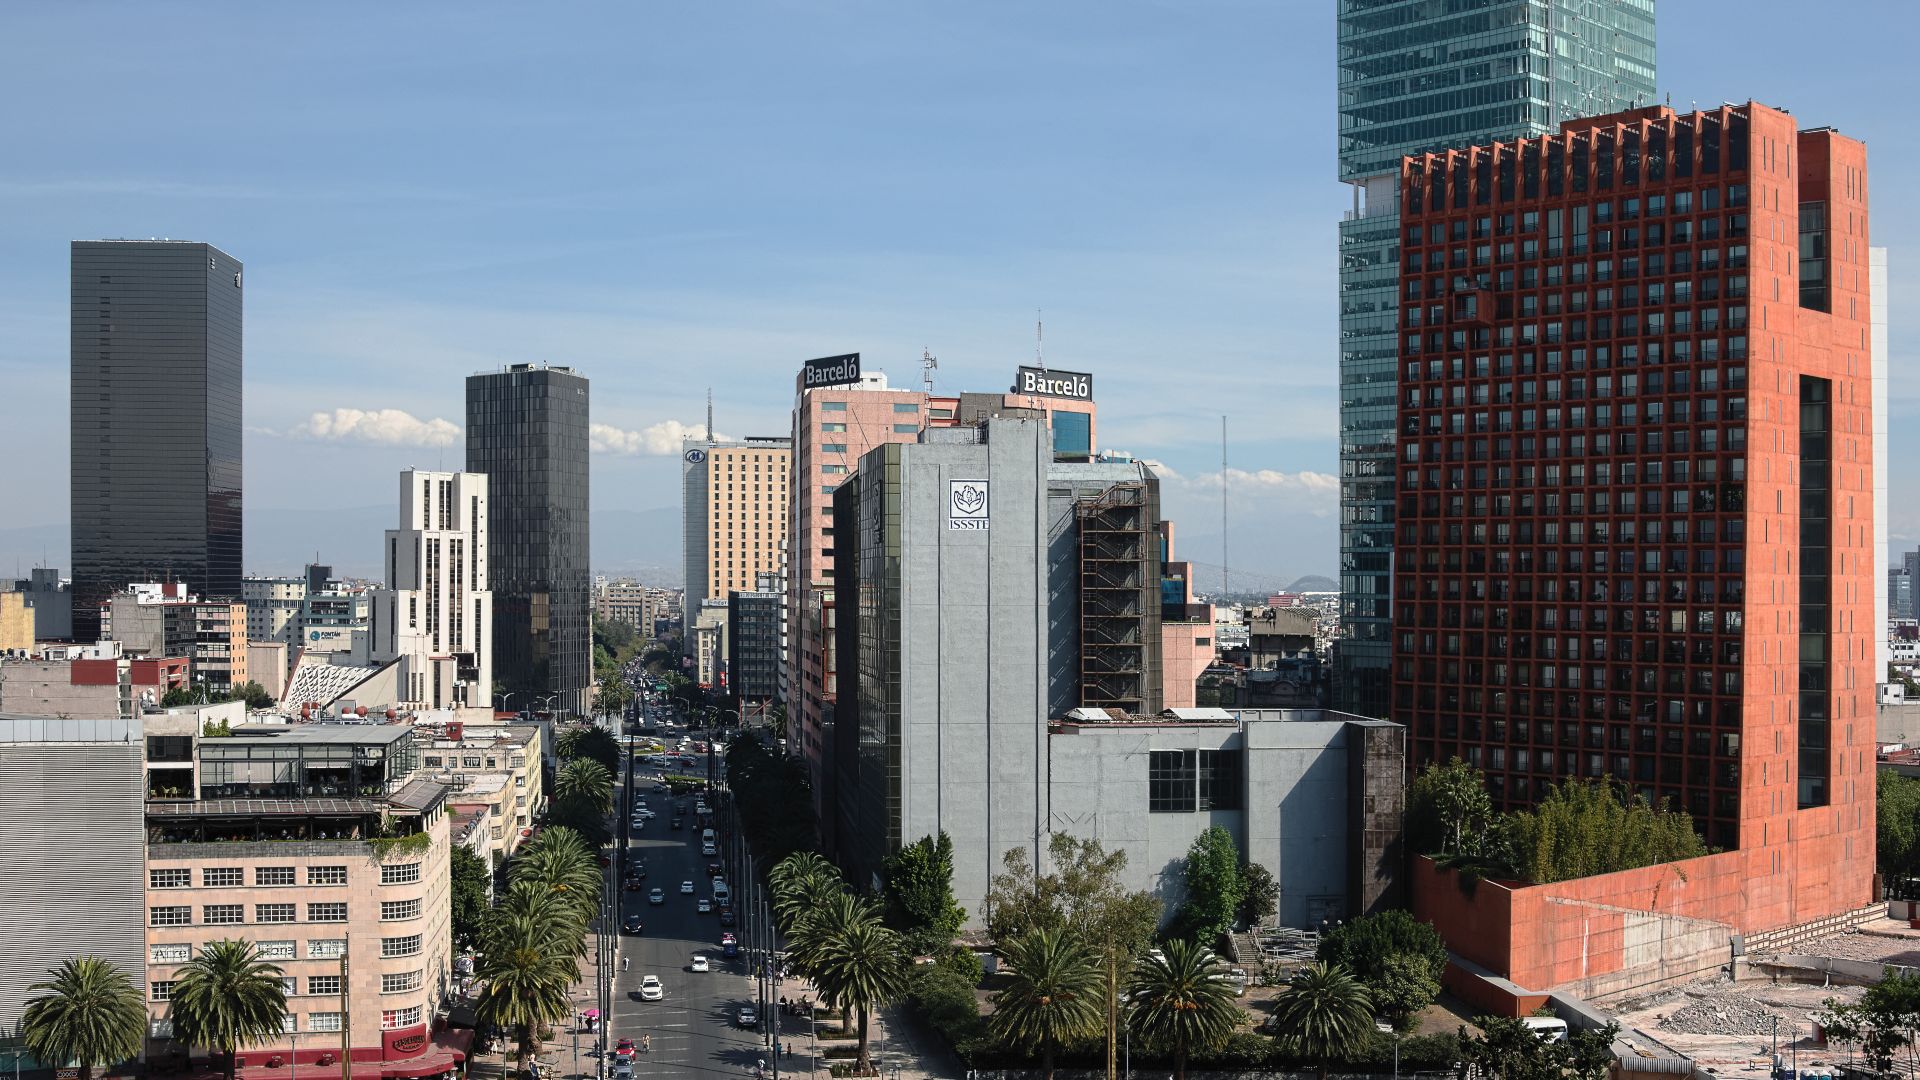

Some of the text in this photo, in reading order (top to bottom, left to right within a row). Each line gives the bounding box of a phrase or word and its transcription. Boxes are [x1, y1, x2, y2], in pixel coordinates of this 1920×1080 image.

[806, 357, 857, 384] Barceló
[1024, 371, 1088, 397] Barceló
[950, 519, 989, 530] ISSSTE
